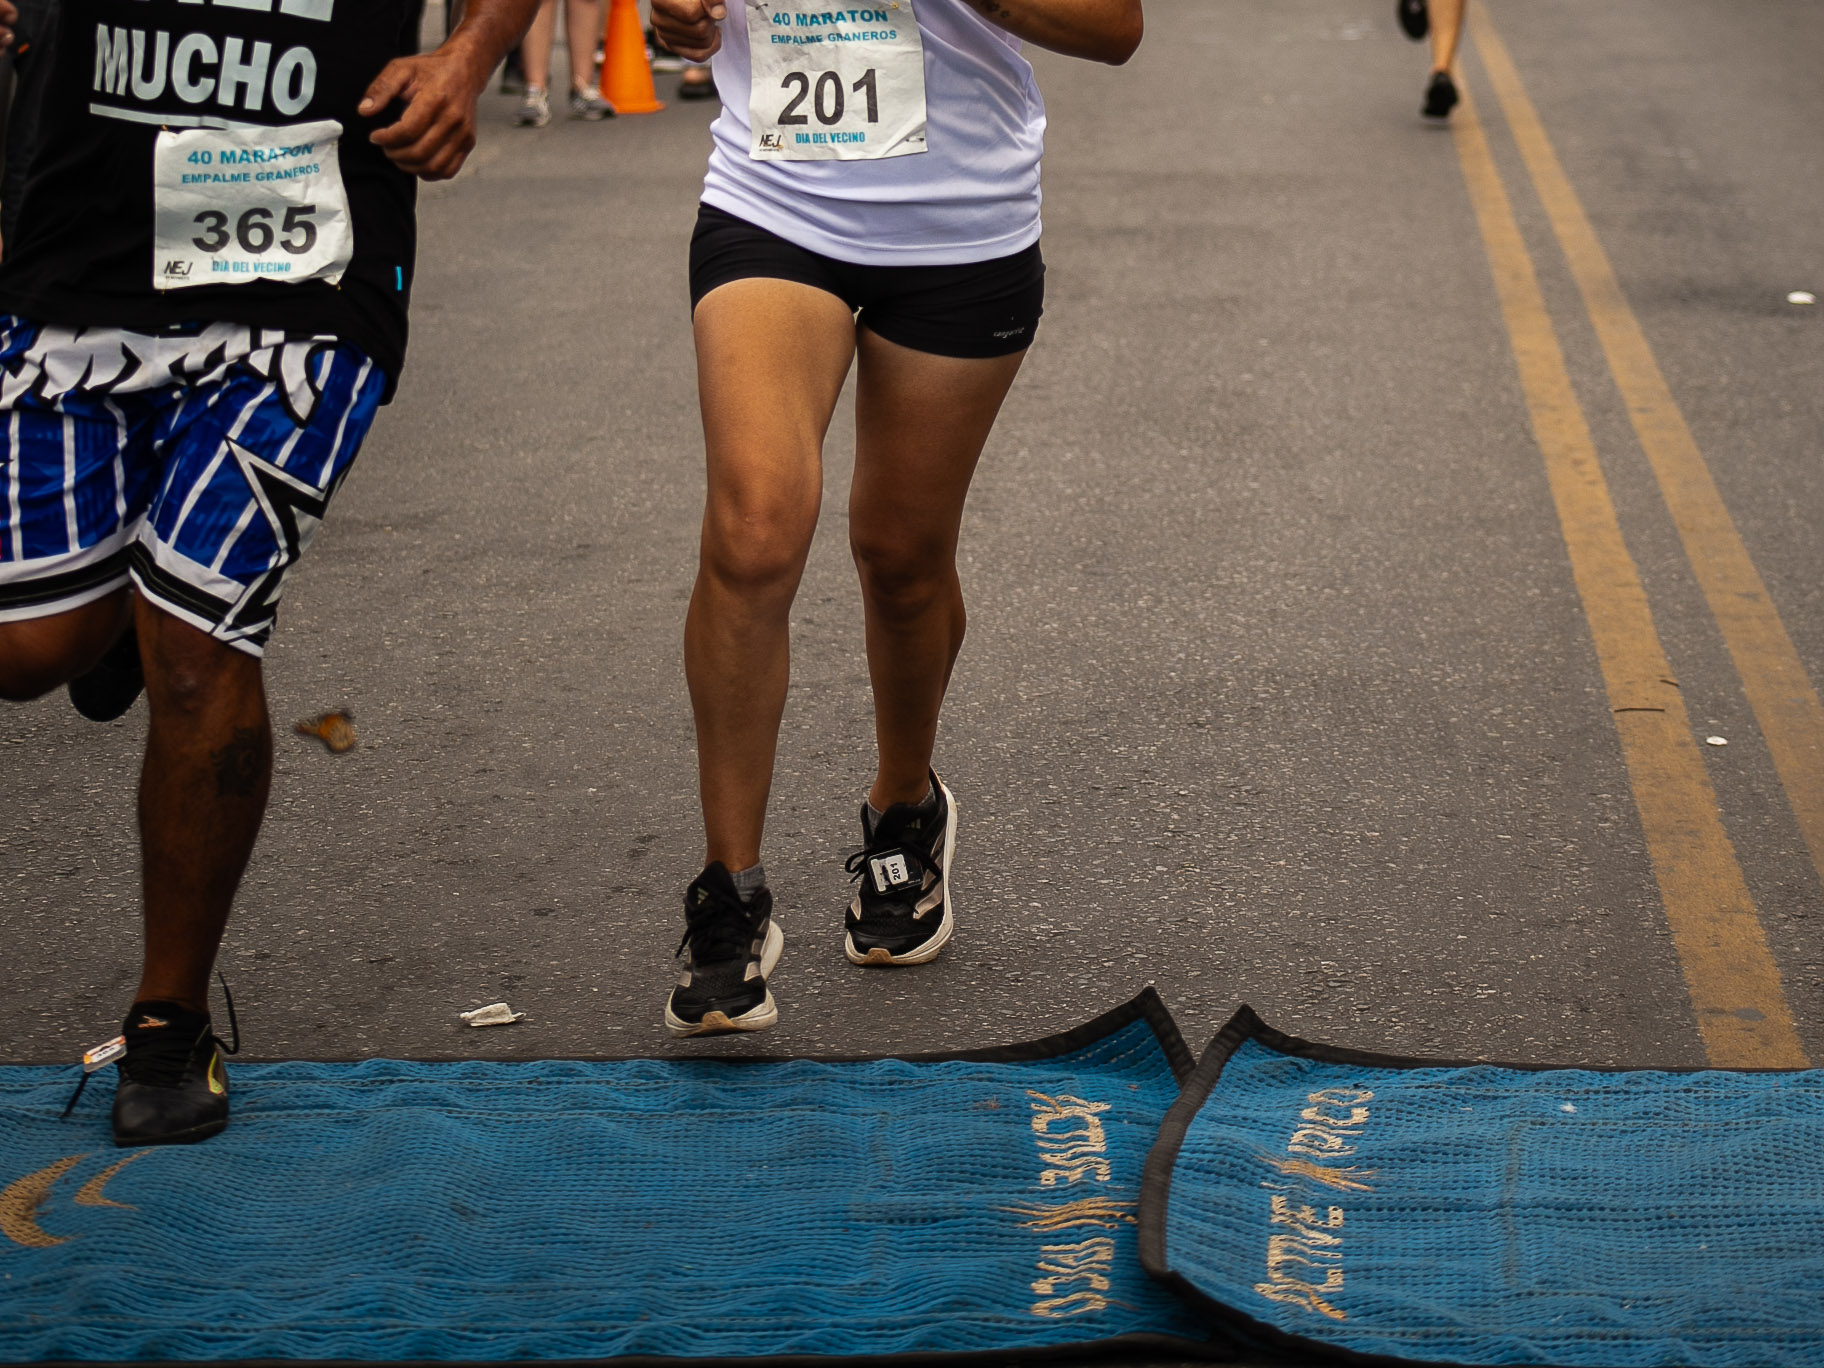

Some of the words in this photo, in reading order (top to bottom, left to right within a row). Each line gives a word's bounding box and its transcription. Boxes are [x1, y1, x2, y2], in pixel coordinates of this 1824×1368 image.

[772, 12, 790, 26] 40
[796, 10, 888, 27] MARATON
[771, 34, 824, 45] EMPALME
[827, 30, 897, 42] GRANEROS
[93, 23, 317, 116] MUCHO
[777, 68, 879, 125] 201
[795, 133, 811, 144] DIA
[813, 133, 828, 143] DEL
[830, 132, 865, 143] VECINO
[187, 150, 213, 165] 40
[220, 143, 315, 164] MARATON
[181, 173, 251, 184] EMPALME
[255, 163, 320, 182] GRANEROS
[192, 204, 318, 255] 365
[164, 261, 193, 275] NEJ
[212, 261, 230, 272] DIA
[232, 261, 250, 272] DEL
[253, 262, 292, 272] VECINO
[890, 862, 902, 881] 201
